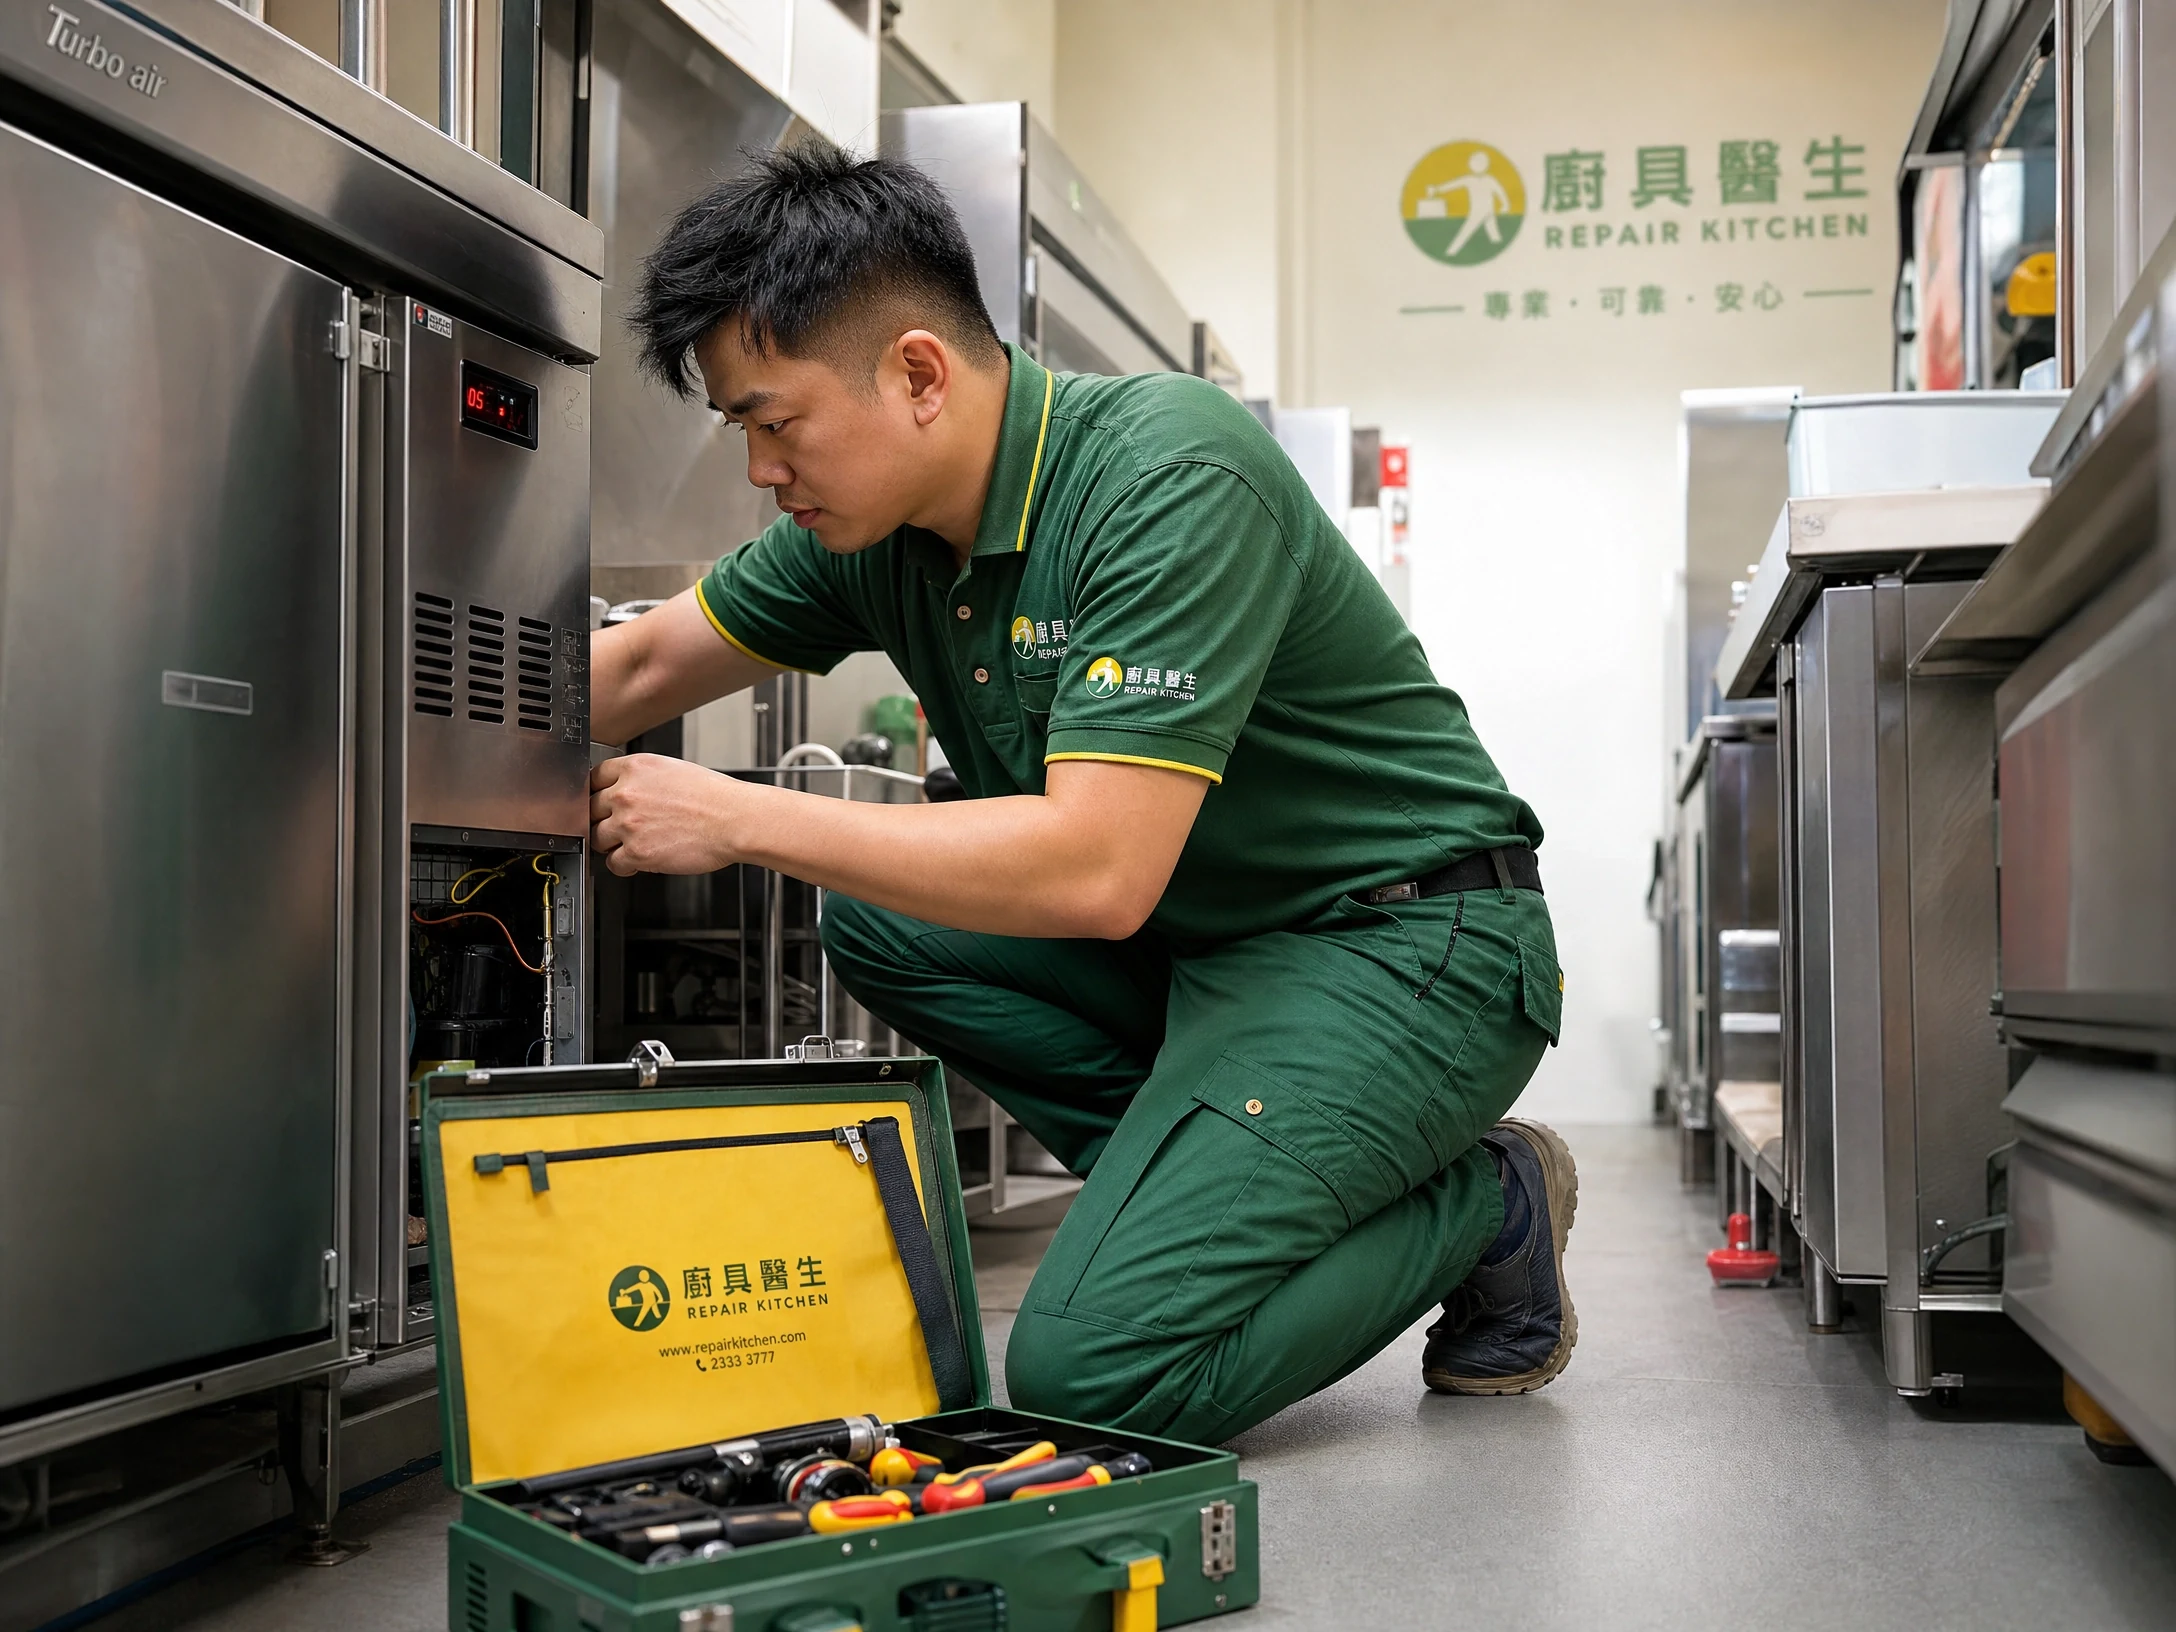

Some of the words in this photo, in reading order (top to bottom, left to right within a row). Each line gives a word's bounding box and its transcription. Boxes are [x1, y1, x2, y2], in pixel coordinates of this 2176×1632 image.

[46, 4, 125, 79] Turbo
[128, 64, 168, 98] air
[1541, 136, 1870, 214] 廚具醫生
[1545, 221, 1681, 249] REPAIR
[1702, 213, 1869, 242] KITCHEN
[1125, 666, 1197, 690] 廚具醫生
[1124, 686, 1157, 697] REPAIR
[1160, 688, 1195, 701] KITCHEN
[682, 1255, 827, 1300] 廚具醫生
[688, 1302, 749, 1320] REPAIR
[756, 1293, 829, 1312] KITCHEN
[659, 1331, 807, 1359] www.repairkitchen.com
[710, 1354, 743, 1371] 2333
[746, 1350, 776, 1367] 3777
